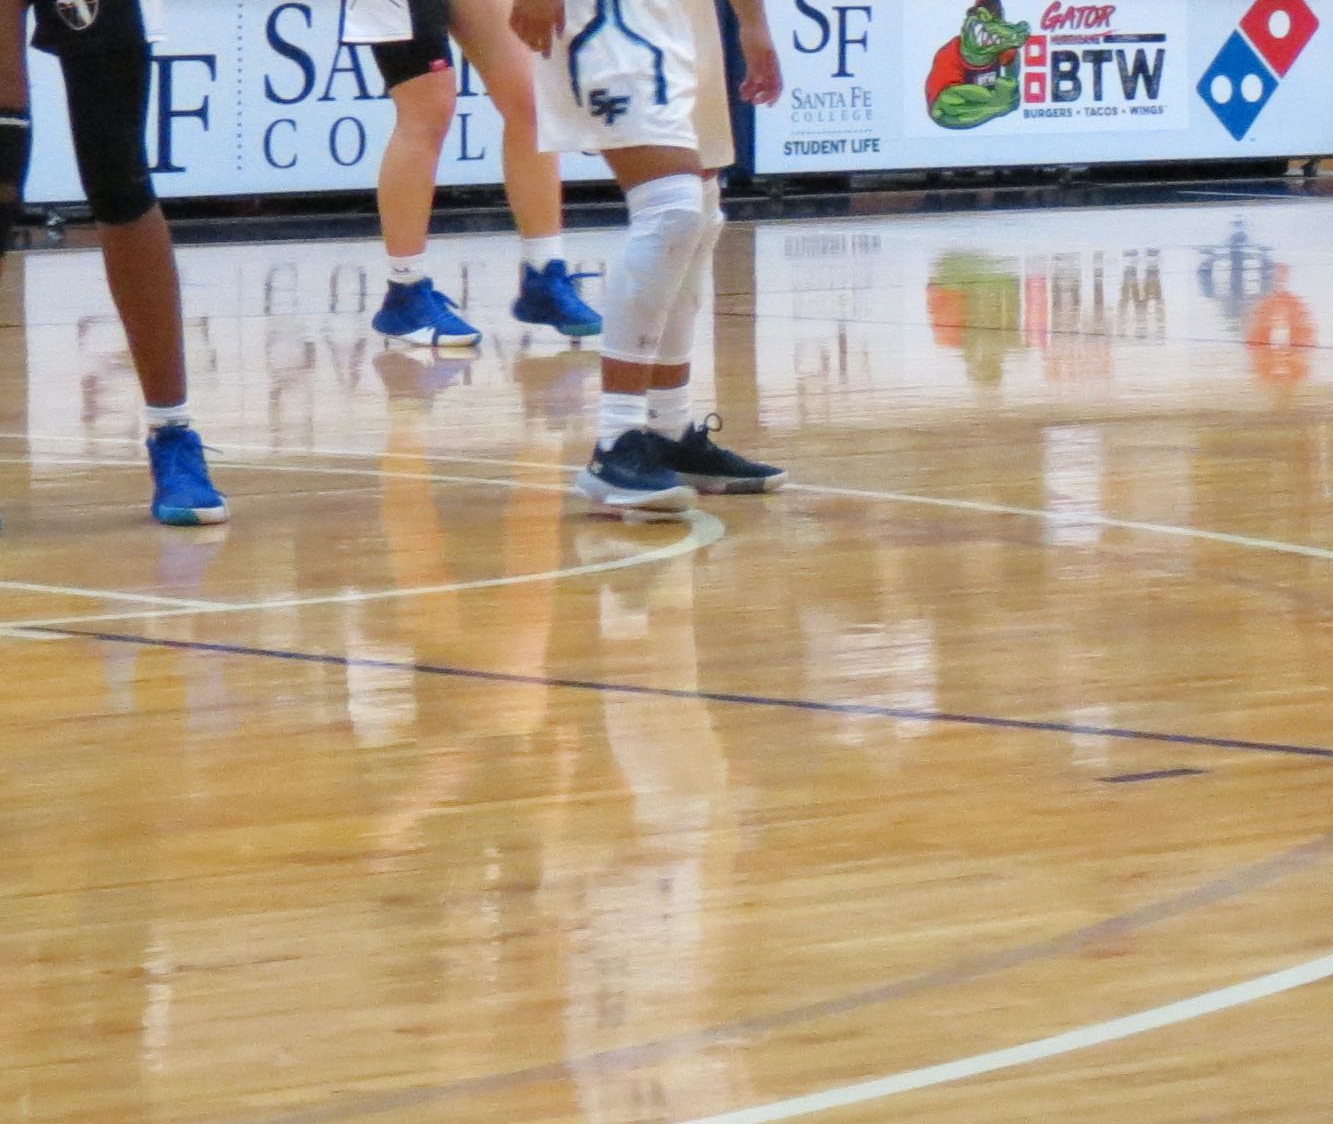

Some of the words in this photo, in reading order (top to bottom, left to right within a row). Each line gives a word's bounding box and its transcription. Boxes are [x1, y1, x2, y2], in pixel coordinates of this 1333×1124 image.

[1040, 0, 1117, 31] GATOR
[1051, 48, 1166, 103] BTW
[791, 87, 846, 109] SANTA
[850, 86, 872, 108] FE
[791, 109, 873, 124] COLLEGE
[1023, 107, 1073, 119] BURGERS
[1084, 106, 1118, 117] TACOS
[1129, 104, 1164, 115] WINGS
[783, 139, 847, 156] STUDENT
[850, 137, 880, 154] LIFE
